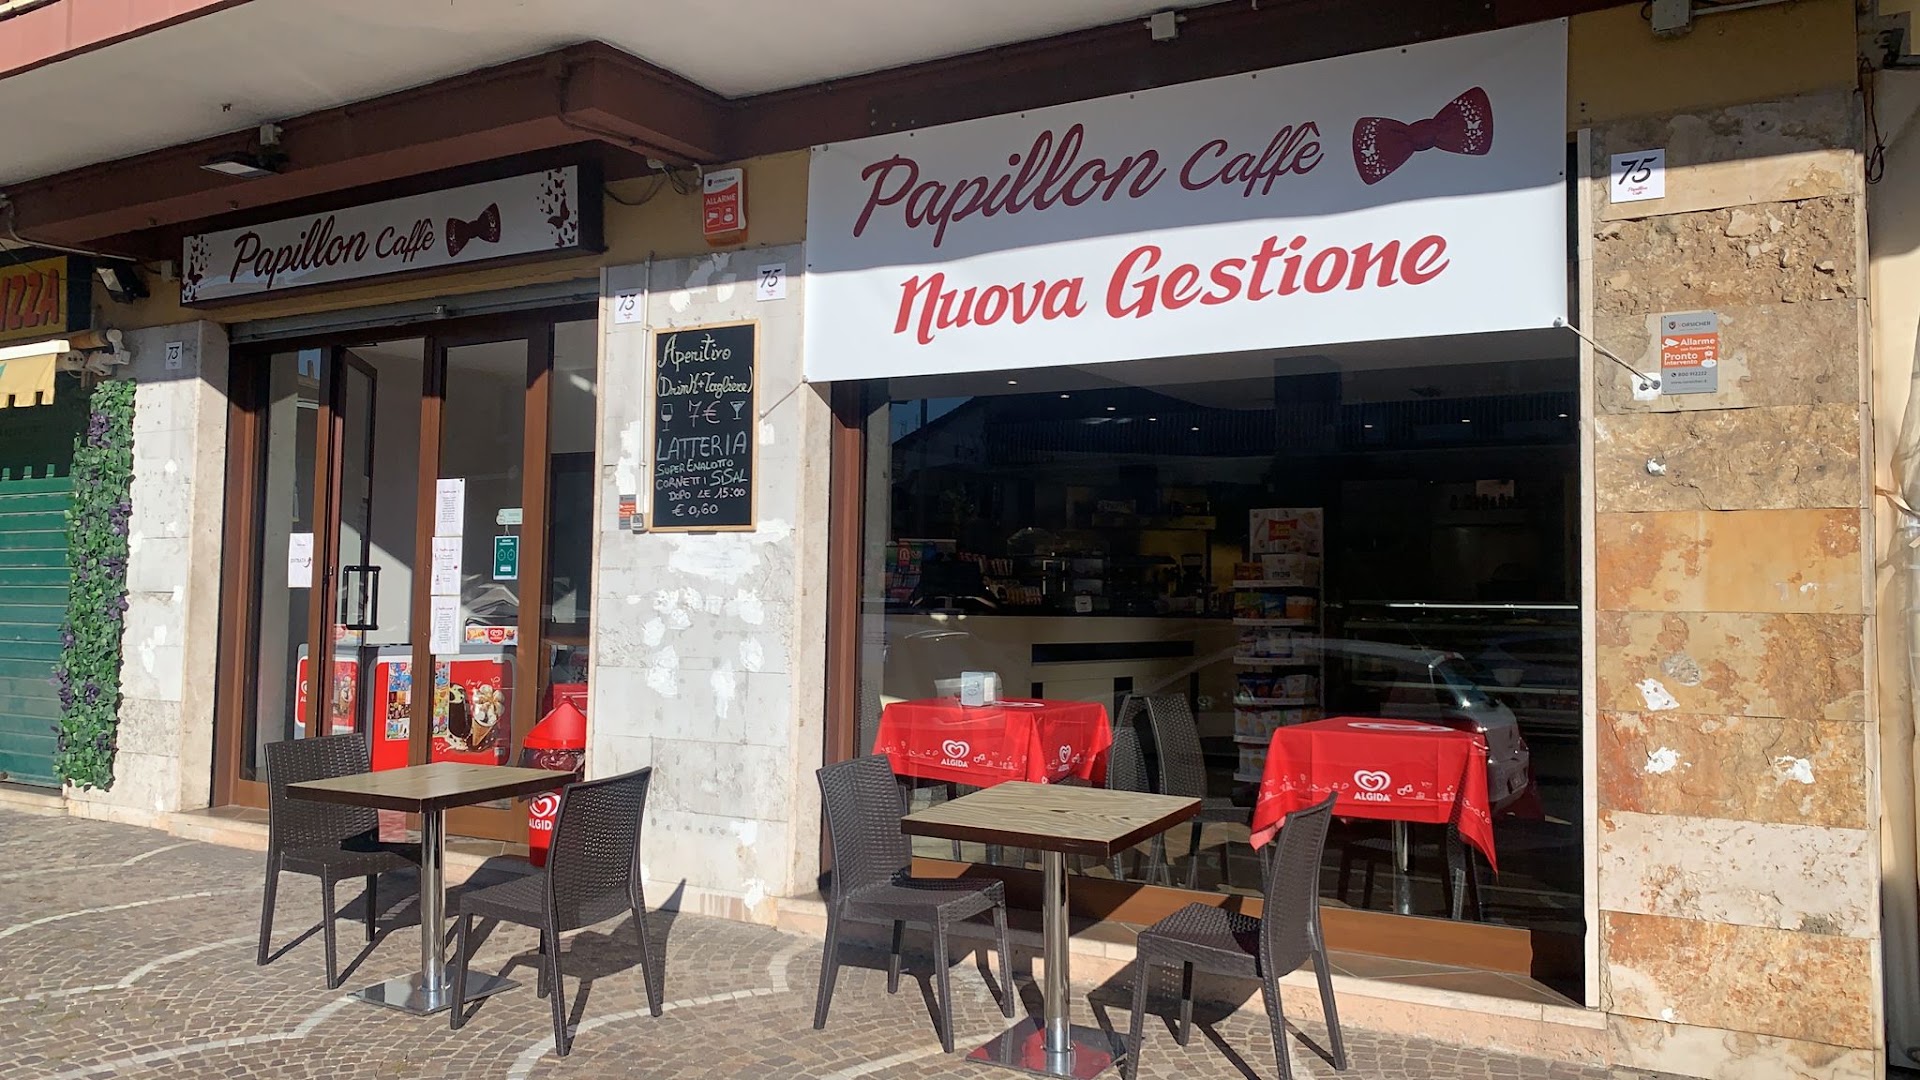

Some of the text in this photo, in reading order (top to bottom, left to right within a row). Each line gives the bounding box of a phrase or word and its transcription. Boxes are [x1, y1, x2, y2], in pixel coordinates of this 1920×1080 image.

[1618, 156, 1657, 185] 75
[853, 123, 1167, 248] Papillon
[706, 194, 736, 205] ALLARME
[230, 214, 369, 290] Papillon
[760, 268, 782, 289] 75
[893, 234, 1452, 345] Nuova Gestione
[618, 293, 637, 312] 73
[1680, 338, 1716, 346] Allarme
[168, 346, 180, 360] 73
[658, 334, 731, 372] Aperitivo
[1664, 352, 1698, 361] Pronto
[657, 432, 747, 461] LATTERIA
[655, 459, 734, 477] SUPER ENALOTTO
[656, 476, 707, 490] CORNETTI
[668, 487, 746, 501] DOPO LE 15:00
[672, 504, 685, 517] €
[940, 757, 969, 768] ALGIDA
[1354, 791, 1391, 802] ALGIDA
[529, 817, 553, 831] LGID
